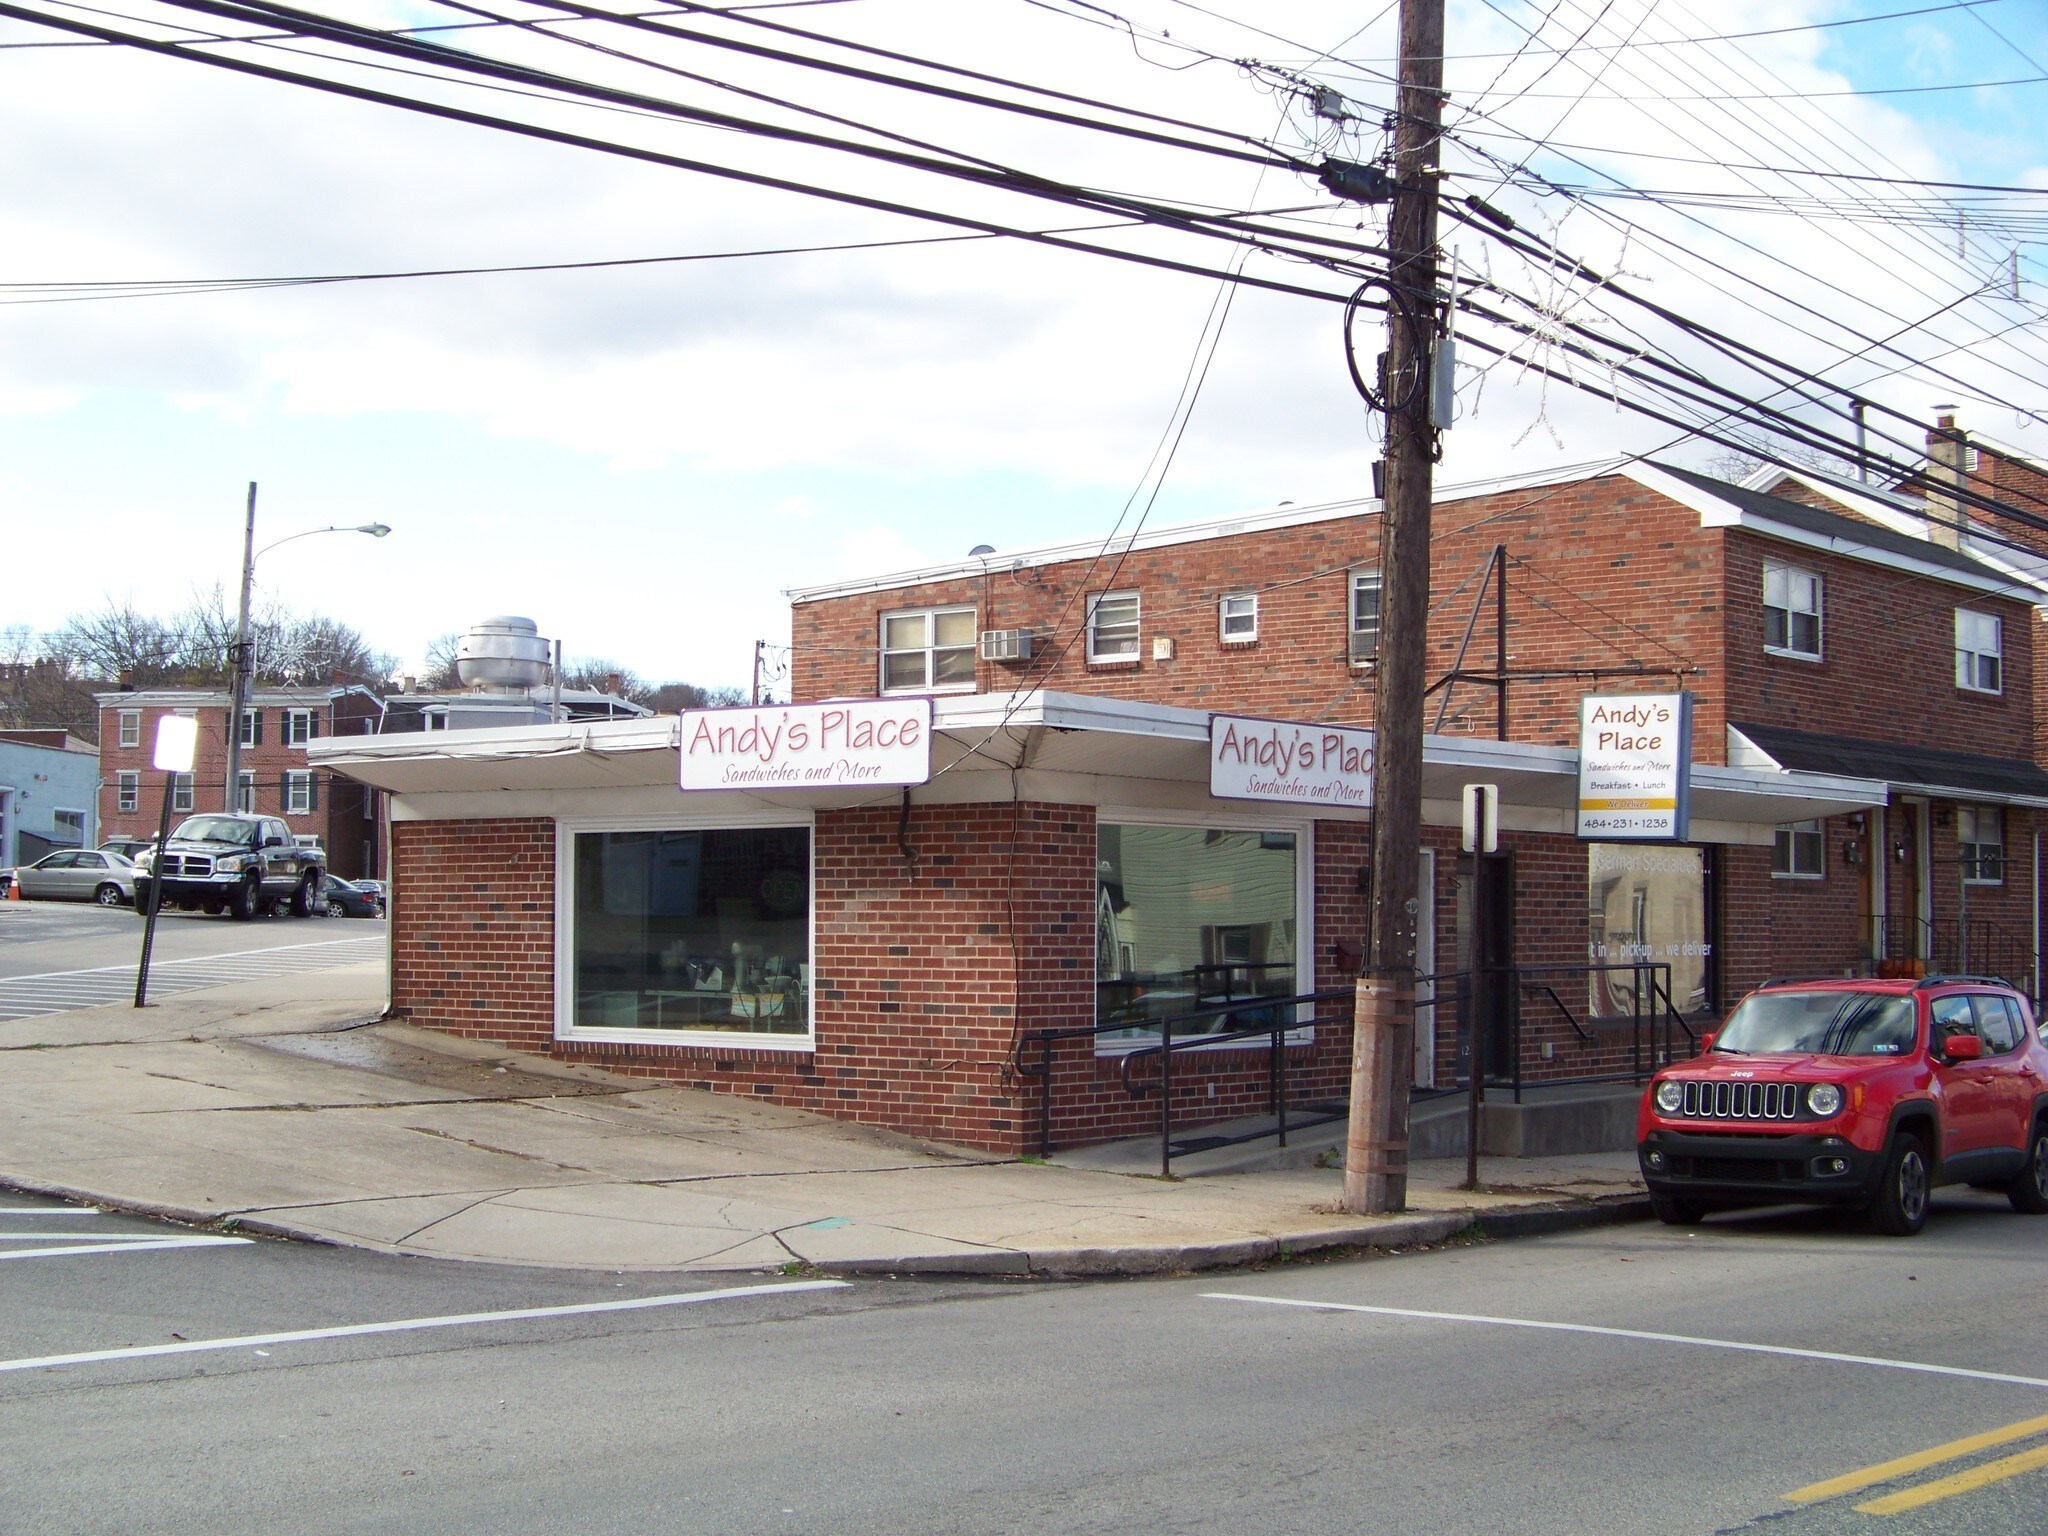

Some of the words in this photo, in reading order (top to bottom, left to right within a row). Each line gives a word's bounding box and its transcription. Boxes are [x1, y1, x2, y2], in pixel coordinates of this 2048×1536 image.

[1590, 703, 1670, 728] Andy's
[689, 711, 809, 763] Andy's
[820, 709, 919, 750] Place
[1598, 731, 1662, 750] Place
[1218, 723, 1314, 777] Andy's
[1322, 734, 1374, 774] Plac
[721, 760, 801, 784] Sandwiches
[804, 761, 831, 780] and
[836, 758, 882, 783] More
[1586, 761, 1631, 772] Sandwiches
[1632, 763, 1645, 771] and
[1646, 760, 1671, 772] More
[1246, 774, 1309, 797] Sandwiches
[1310, 782, 1332, 798] and
[1333, 780, 1364, 802] More
[1590, 781, 1632, 790] Breakfast
[1642, 781, 1666, 790] Lunch
[1607, 800, 1619, 809] We
[1595, 852, 1639, 871] German
[1643, 852, 1697, 874] Specialties
[1598, 941, 1606, 957] in
[1666, 945, 1679, 956] we
[1682, 941, 1711, 956] deliver
[1730, 1070, 1754, 1079] Jeep
